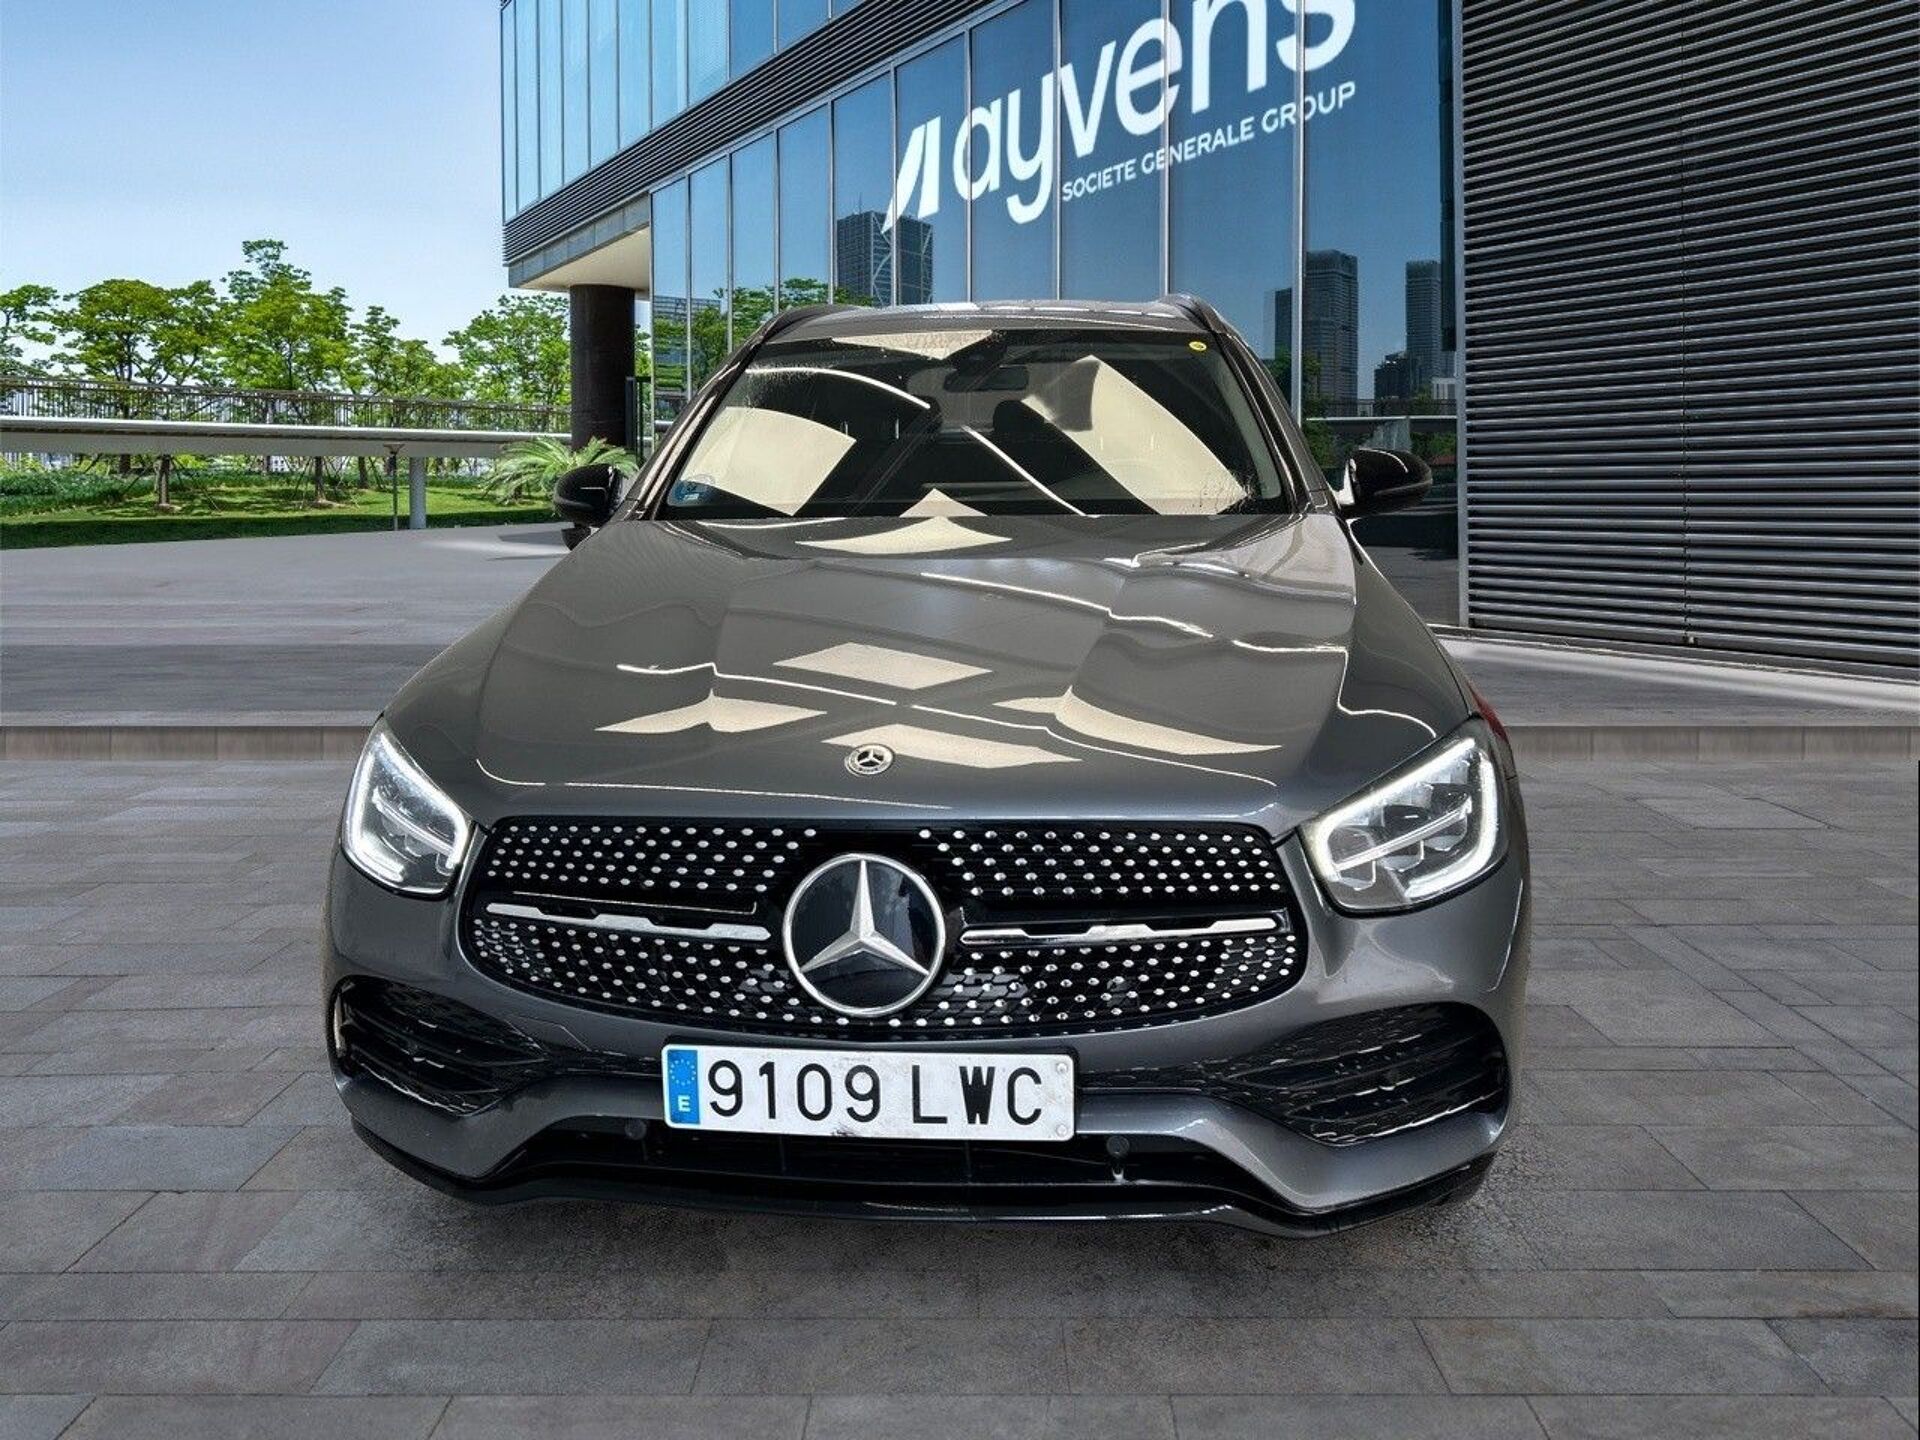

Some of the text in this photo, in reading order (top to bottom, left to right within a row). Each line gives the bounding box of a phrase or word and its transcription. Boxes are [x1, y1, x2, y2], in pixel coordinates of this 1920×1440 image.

[952, 0, 1355, 224] ayvens
[1062, 80, 1357, 202] SOCIETE GENERALE GROUP
[678, 1094, 690, 1112] E
[707, 1059, 1043, 1126] 9109 LWC
